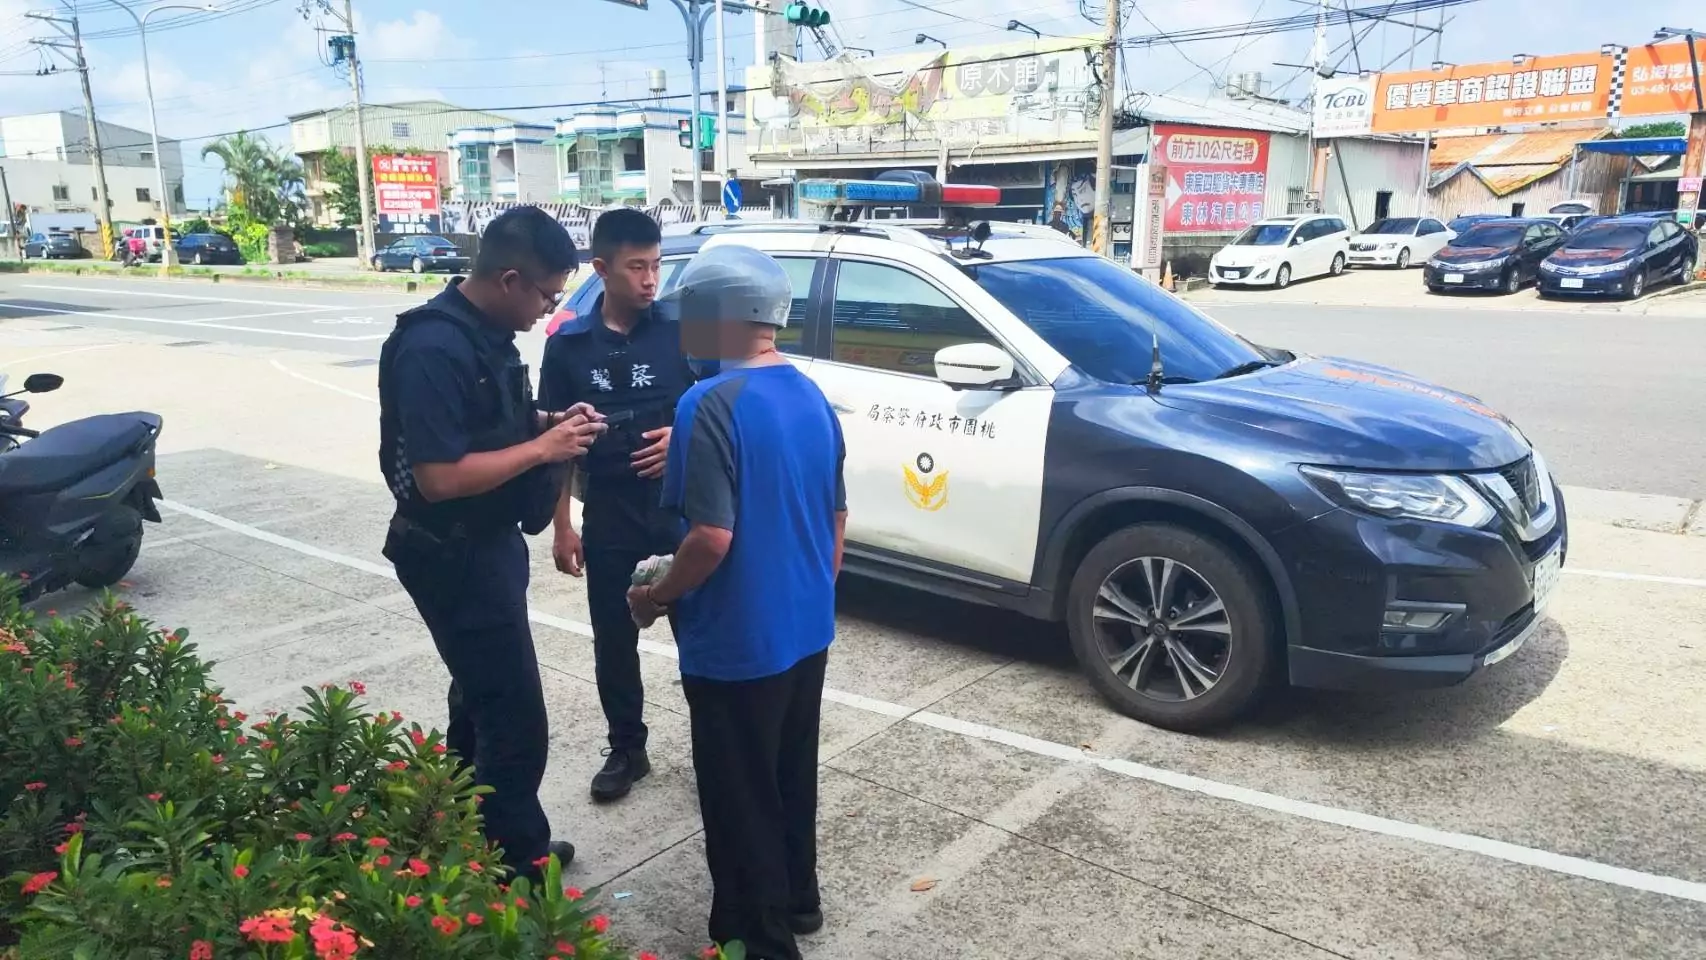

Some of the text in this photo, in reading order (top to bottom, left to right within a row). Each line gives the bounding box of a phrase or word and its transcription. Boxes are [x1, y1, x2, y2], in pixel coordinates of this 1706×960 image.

[960, 57, 1040, 90] 原木館
[1385, 64, 1598, 110] 優質車商認證聯盟
[1323, 91, 1368, 109] TCBU
[1171, 138, 1254, 161] 前方10公尺右轉
[1181, 201, 1262, 226] 東林汽車公司
[590, 363, 656, 392] 警察
